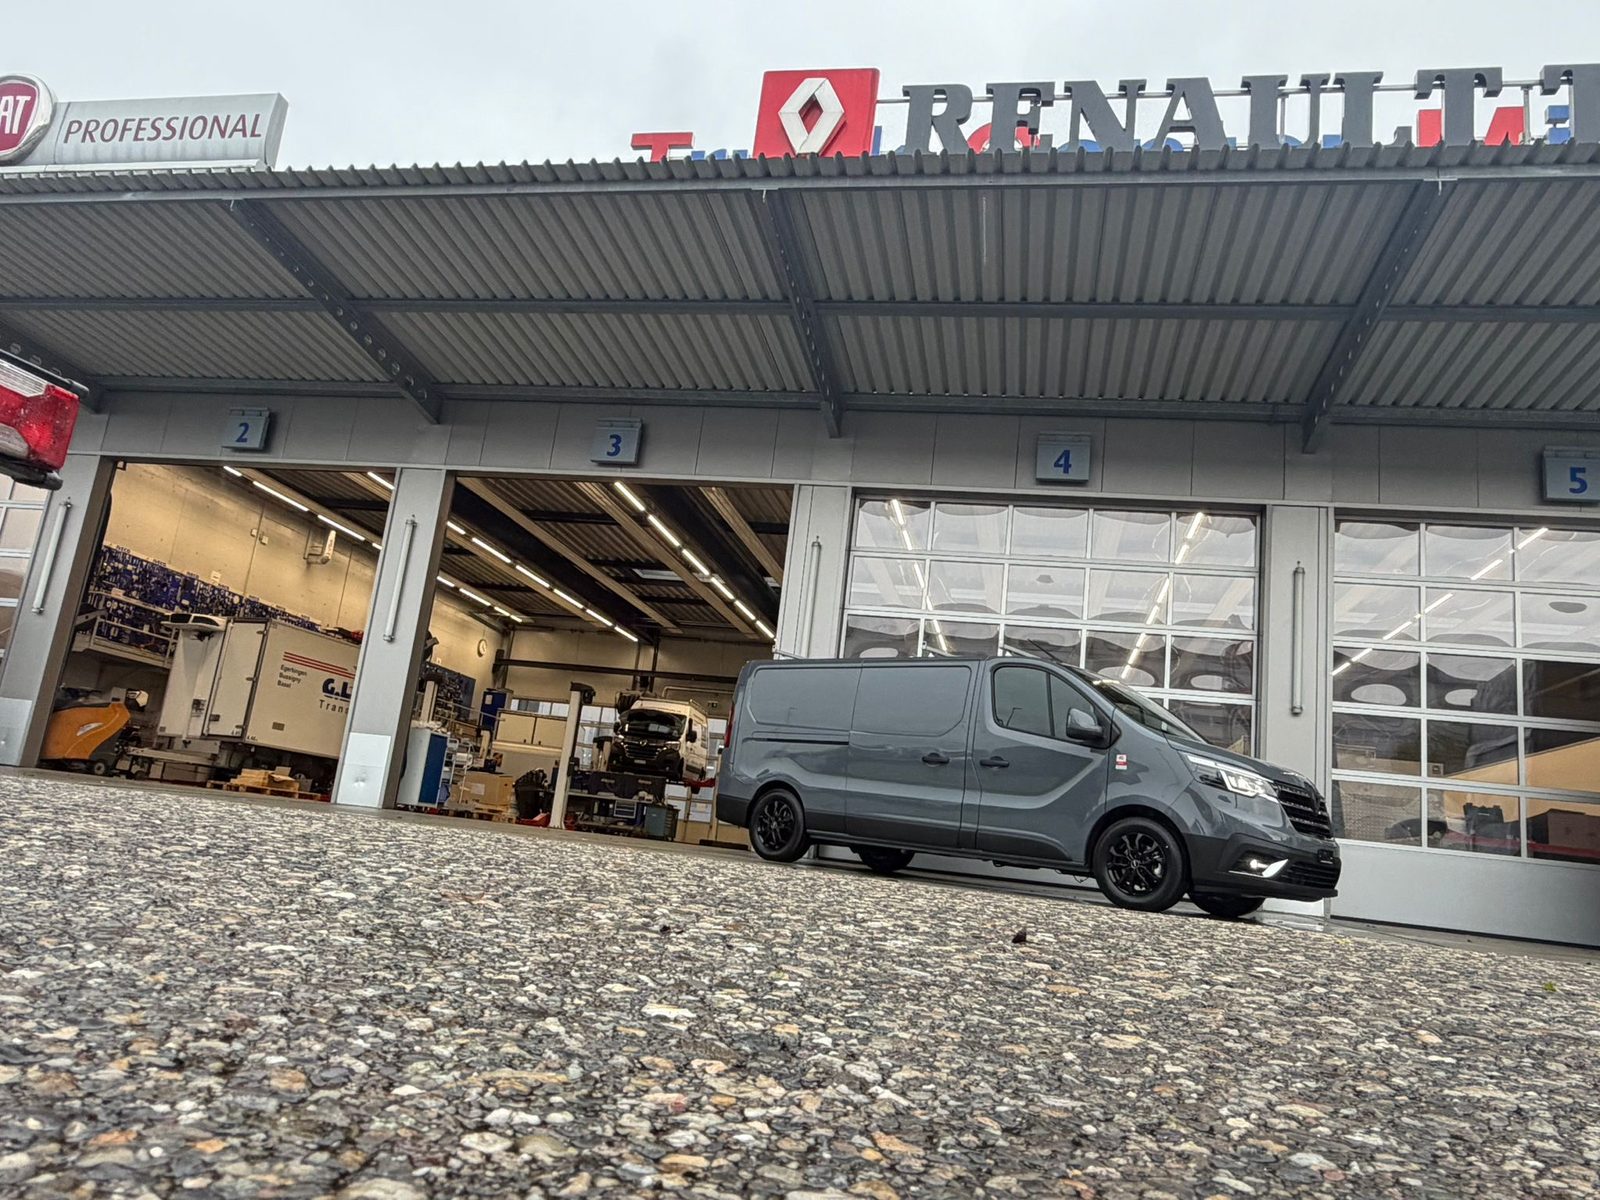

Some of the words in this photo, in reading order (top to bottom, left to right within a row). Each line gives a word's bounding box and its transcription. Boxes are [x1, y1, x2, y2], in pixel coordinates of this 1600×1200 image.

[902, 67, 1503, 154] RENAULT
[63, 113, 262, 144] PROFESSIONAL
[235, 422, 250, 443] 2
[606, 433, 622, 457] 3
[1053, 449, 1072, 474] 4
[1568, 466, 1588, 494] 5
